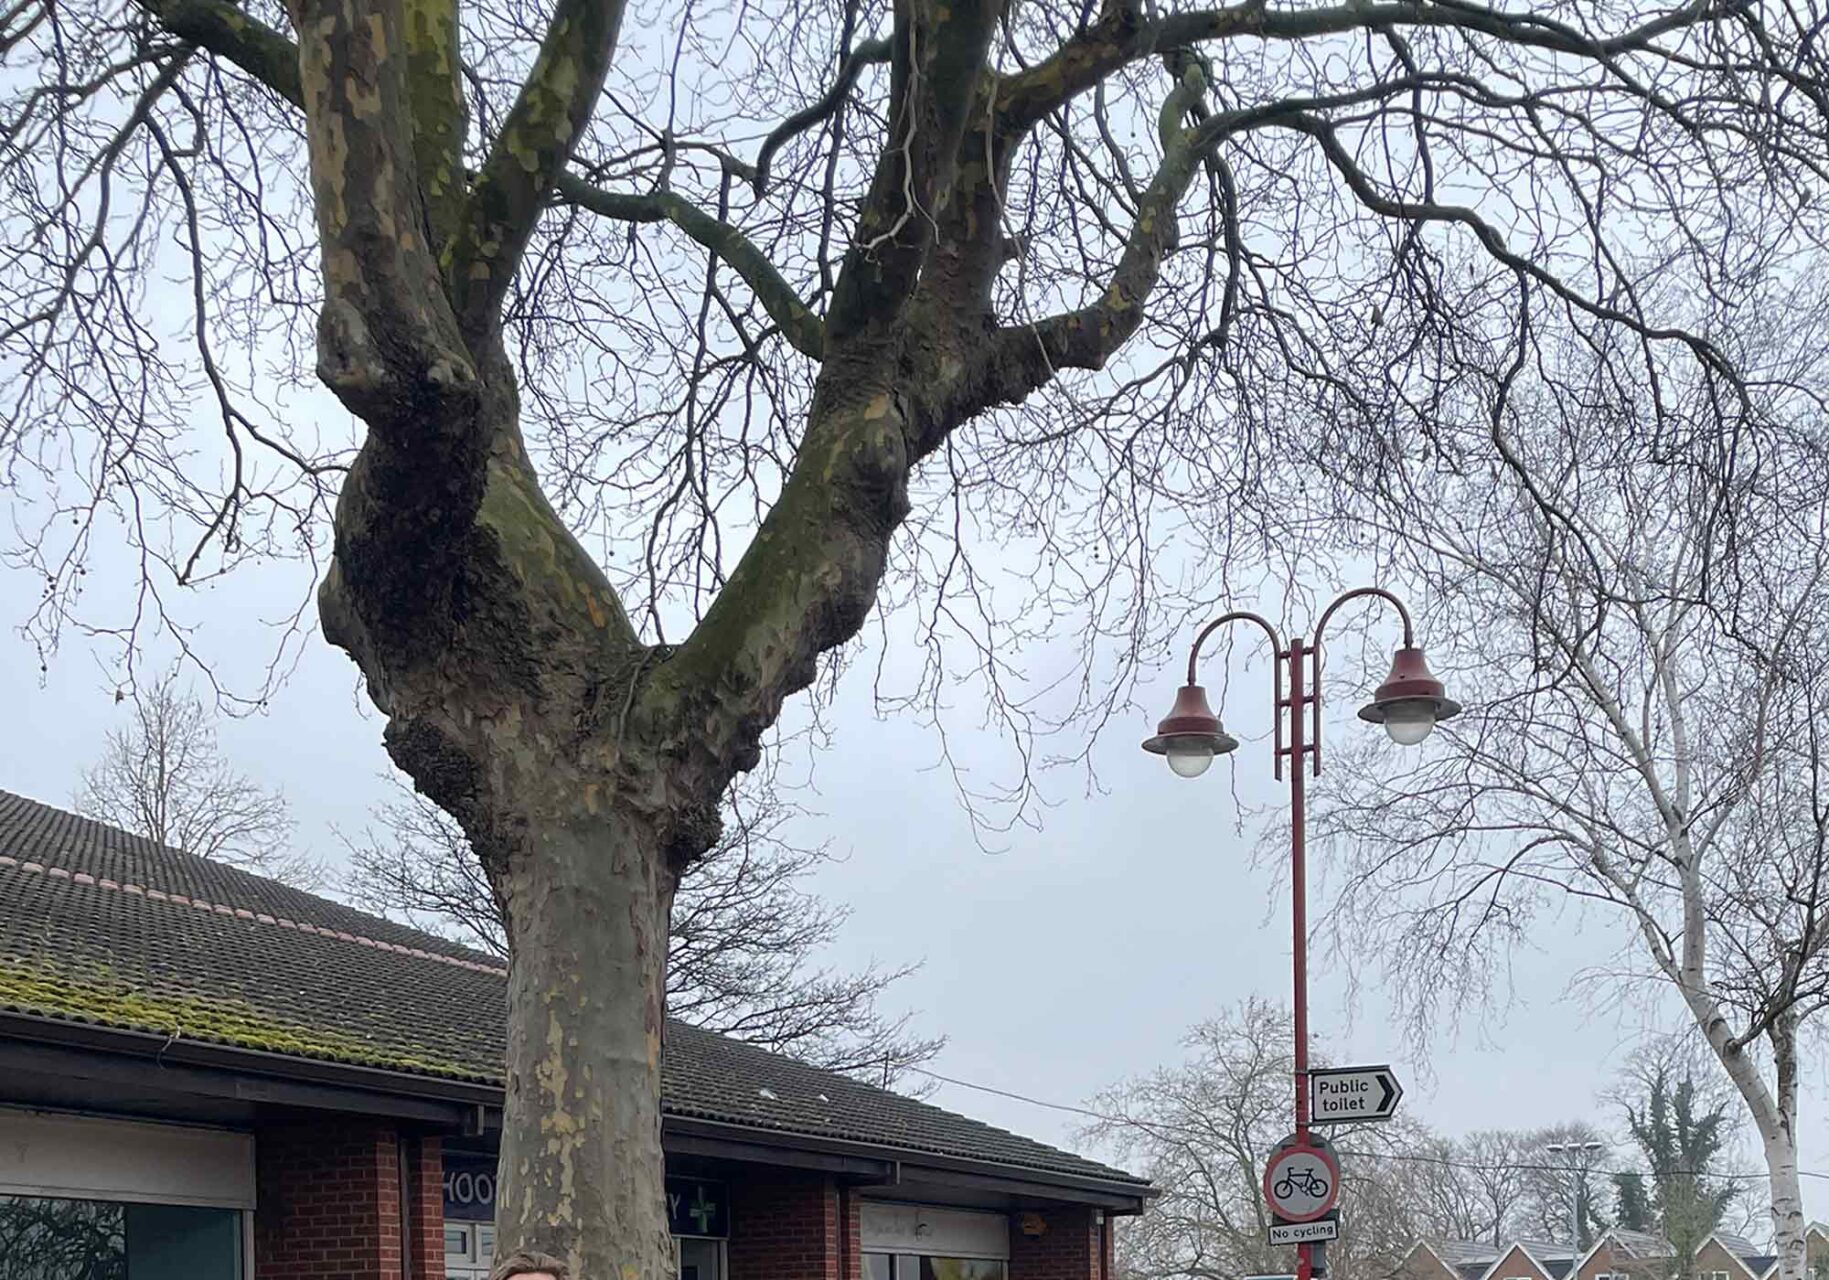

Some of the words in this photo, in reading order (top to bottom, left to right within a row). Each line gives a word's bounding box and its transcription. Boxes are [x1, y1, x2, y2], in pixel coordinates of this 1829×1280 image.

[1319, 1079, 1369, 1095] Public
[1323, 1097, 1365, 1112] toilet
[1272, 1229, 1289, 1239] No
[1293, 1225, 1333, 1238] cycling
